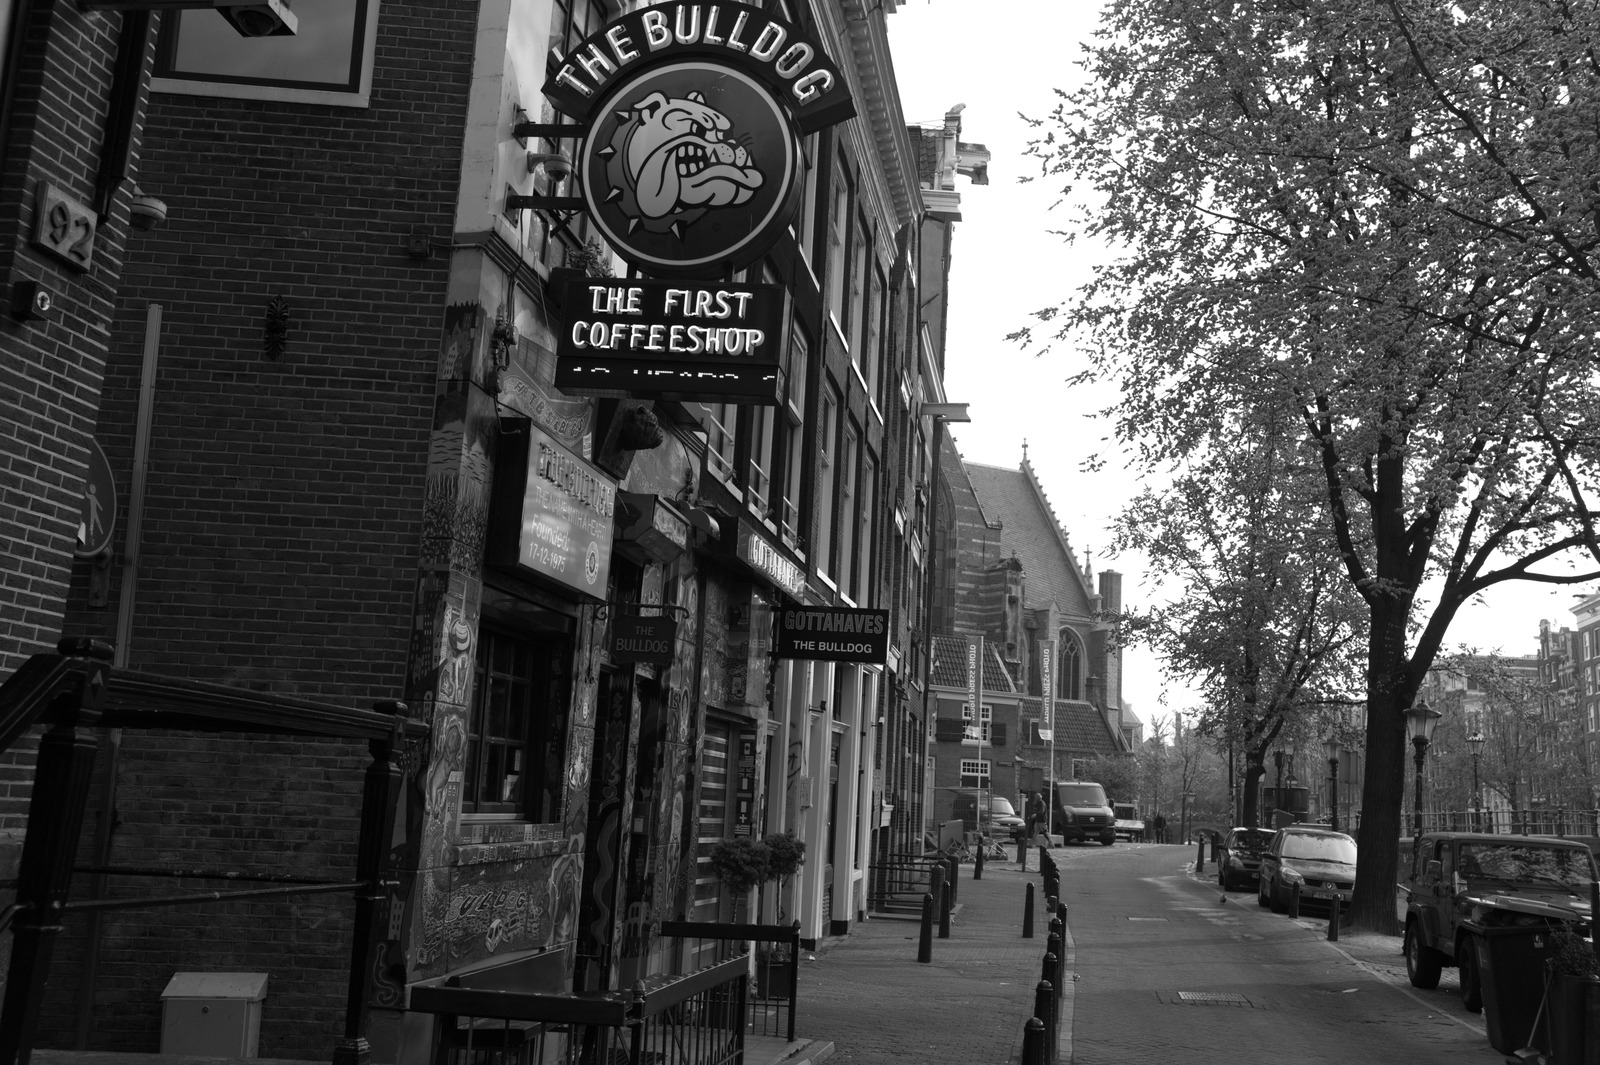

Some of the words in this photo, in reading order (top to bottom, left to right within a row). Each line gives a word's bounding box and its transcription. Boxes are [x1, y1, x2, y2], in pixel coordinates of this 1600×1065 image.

[555, 24, 639, 98] THE
[642, 4, 836, 105] BULLDOG
[51, 201, 93, 261] 92
[589, 286, 643, 315] THE
[664, 288, 753, 319] FIRST
[572, 321, 766, 356] COFFEESHOP
[531, 513, 570, 552] Founded:
[529, 541, 566, 573] 17-12-1975
[634, 625, 655, 636] THE
[785, 611, 884, 634] GOTTAHAVES
[615, 638, 668, 653] BULLDOG
[793, 640, 815, 650] THE
[818, 641, 872, 654] BULLDOG
[445, 889, 526, 923] BULLDOG
